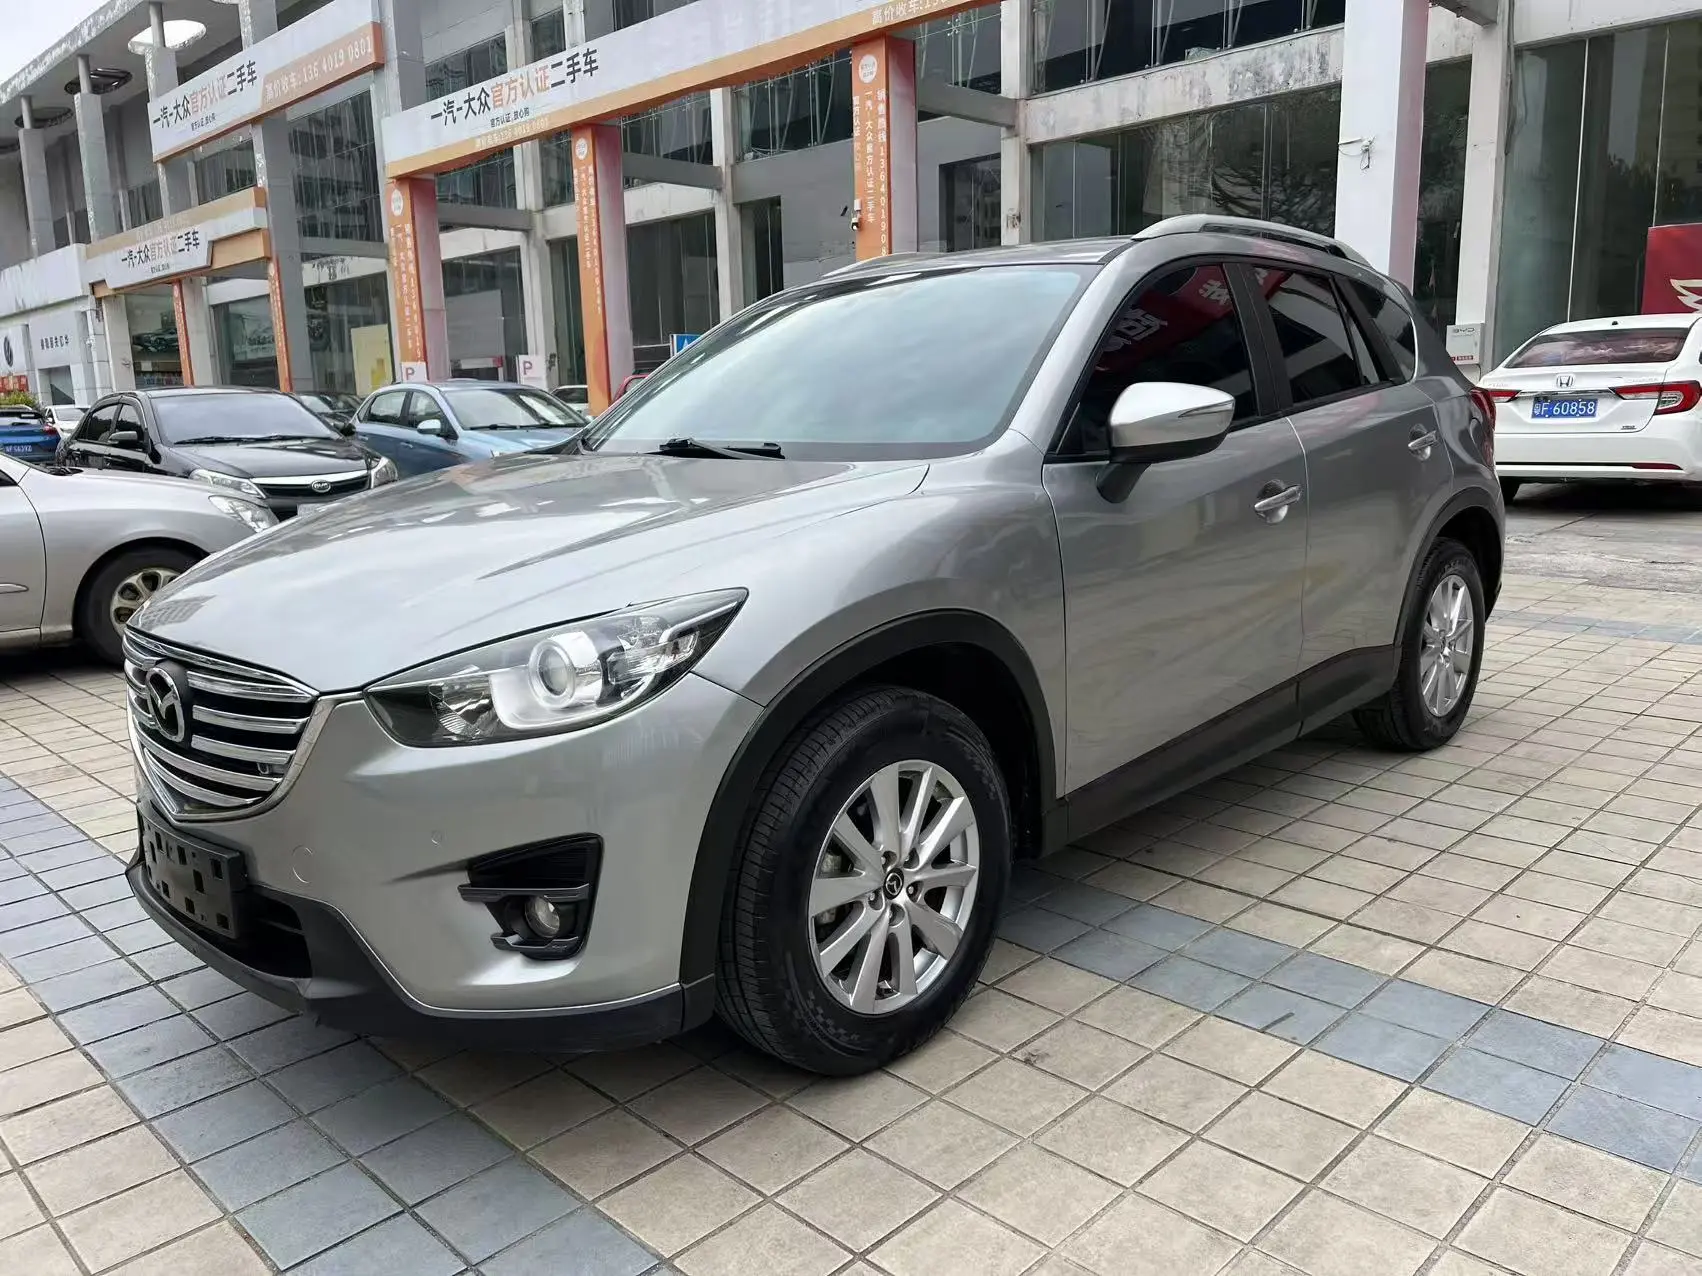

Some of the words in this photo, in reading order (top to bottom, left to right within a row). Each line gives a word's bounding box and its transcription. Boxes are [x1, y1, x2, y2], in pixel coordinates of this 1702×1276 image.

[431, 47, 599, 126] 一汽-大众官方认证二手车
[405, 366, 415, 380] P
[523, 360, 533, 375] P
